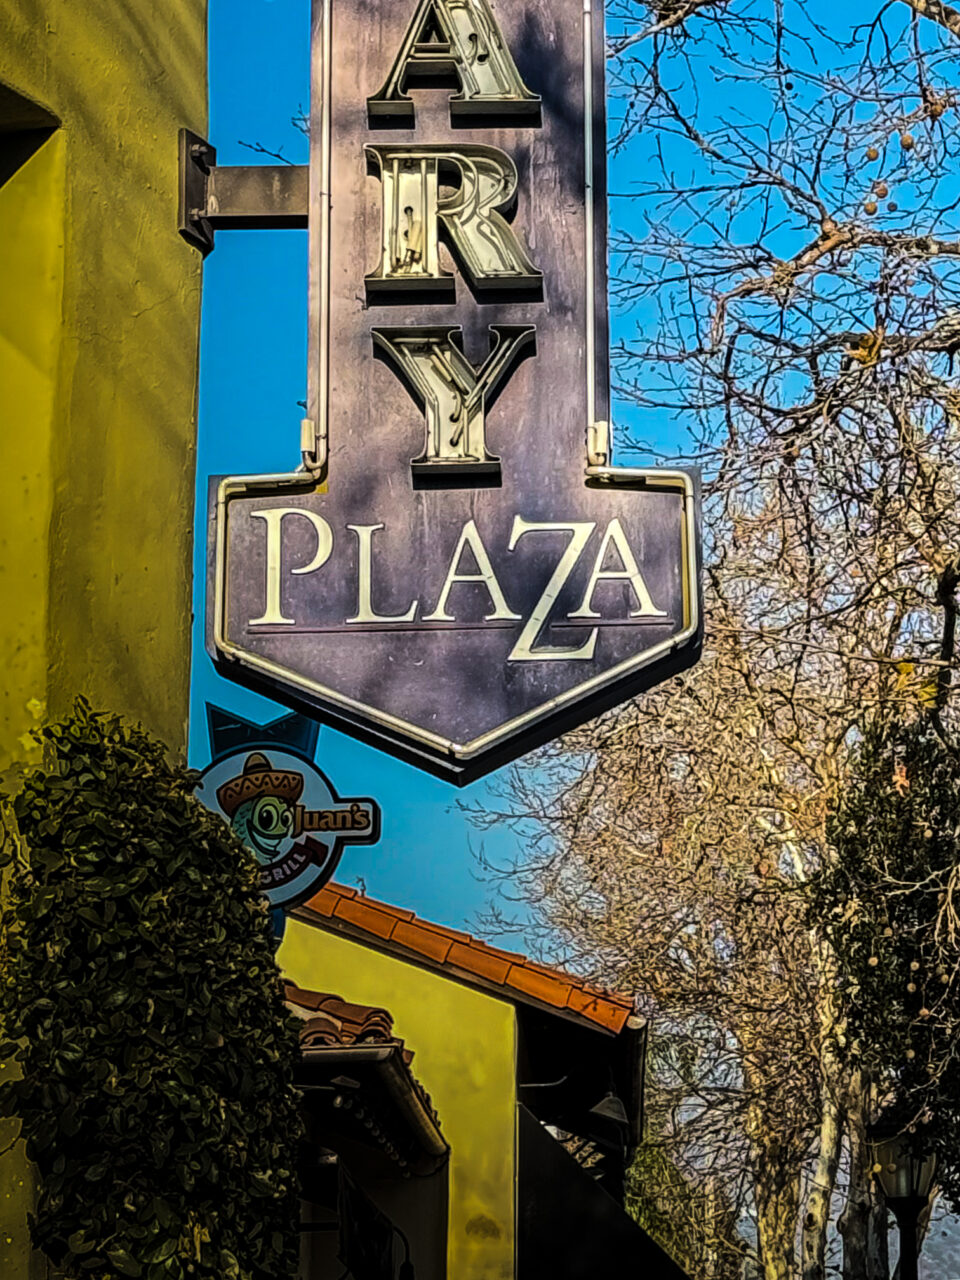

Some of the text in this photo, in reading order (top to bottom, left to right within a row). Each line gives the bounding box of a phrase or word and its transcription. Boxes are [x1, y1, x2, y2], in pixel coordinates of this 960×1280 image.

[248, 506, 668, 662] PLAZA
[293, 804, 369, 837] Juan's
[259, 852, 307, 885] GRILL
